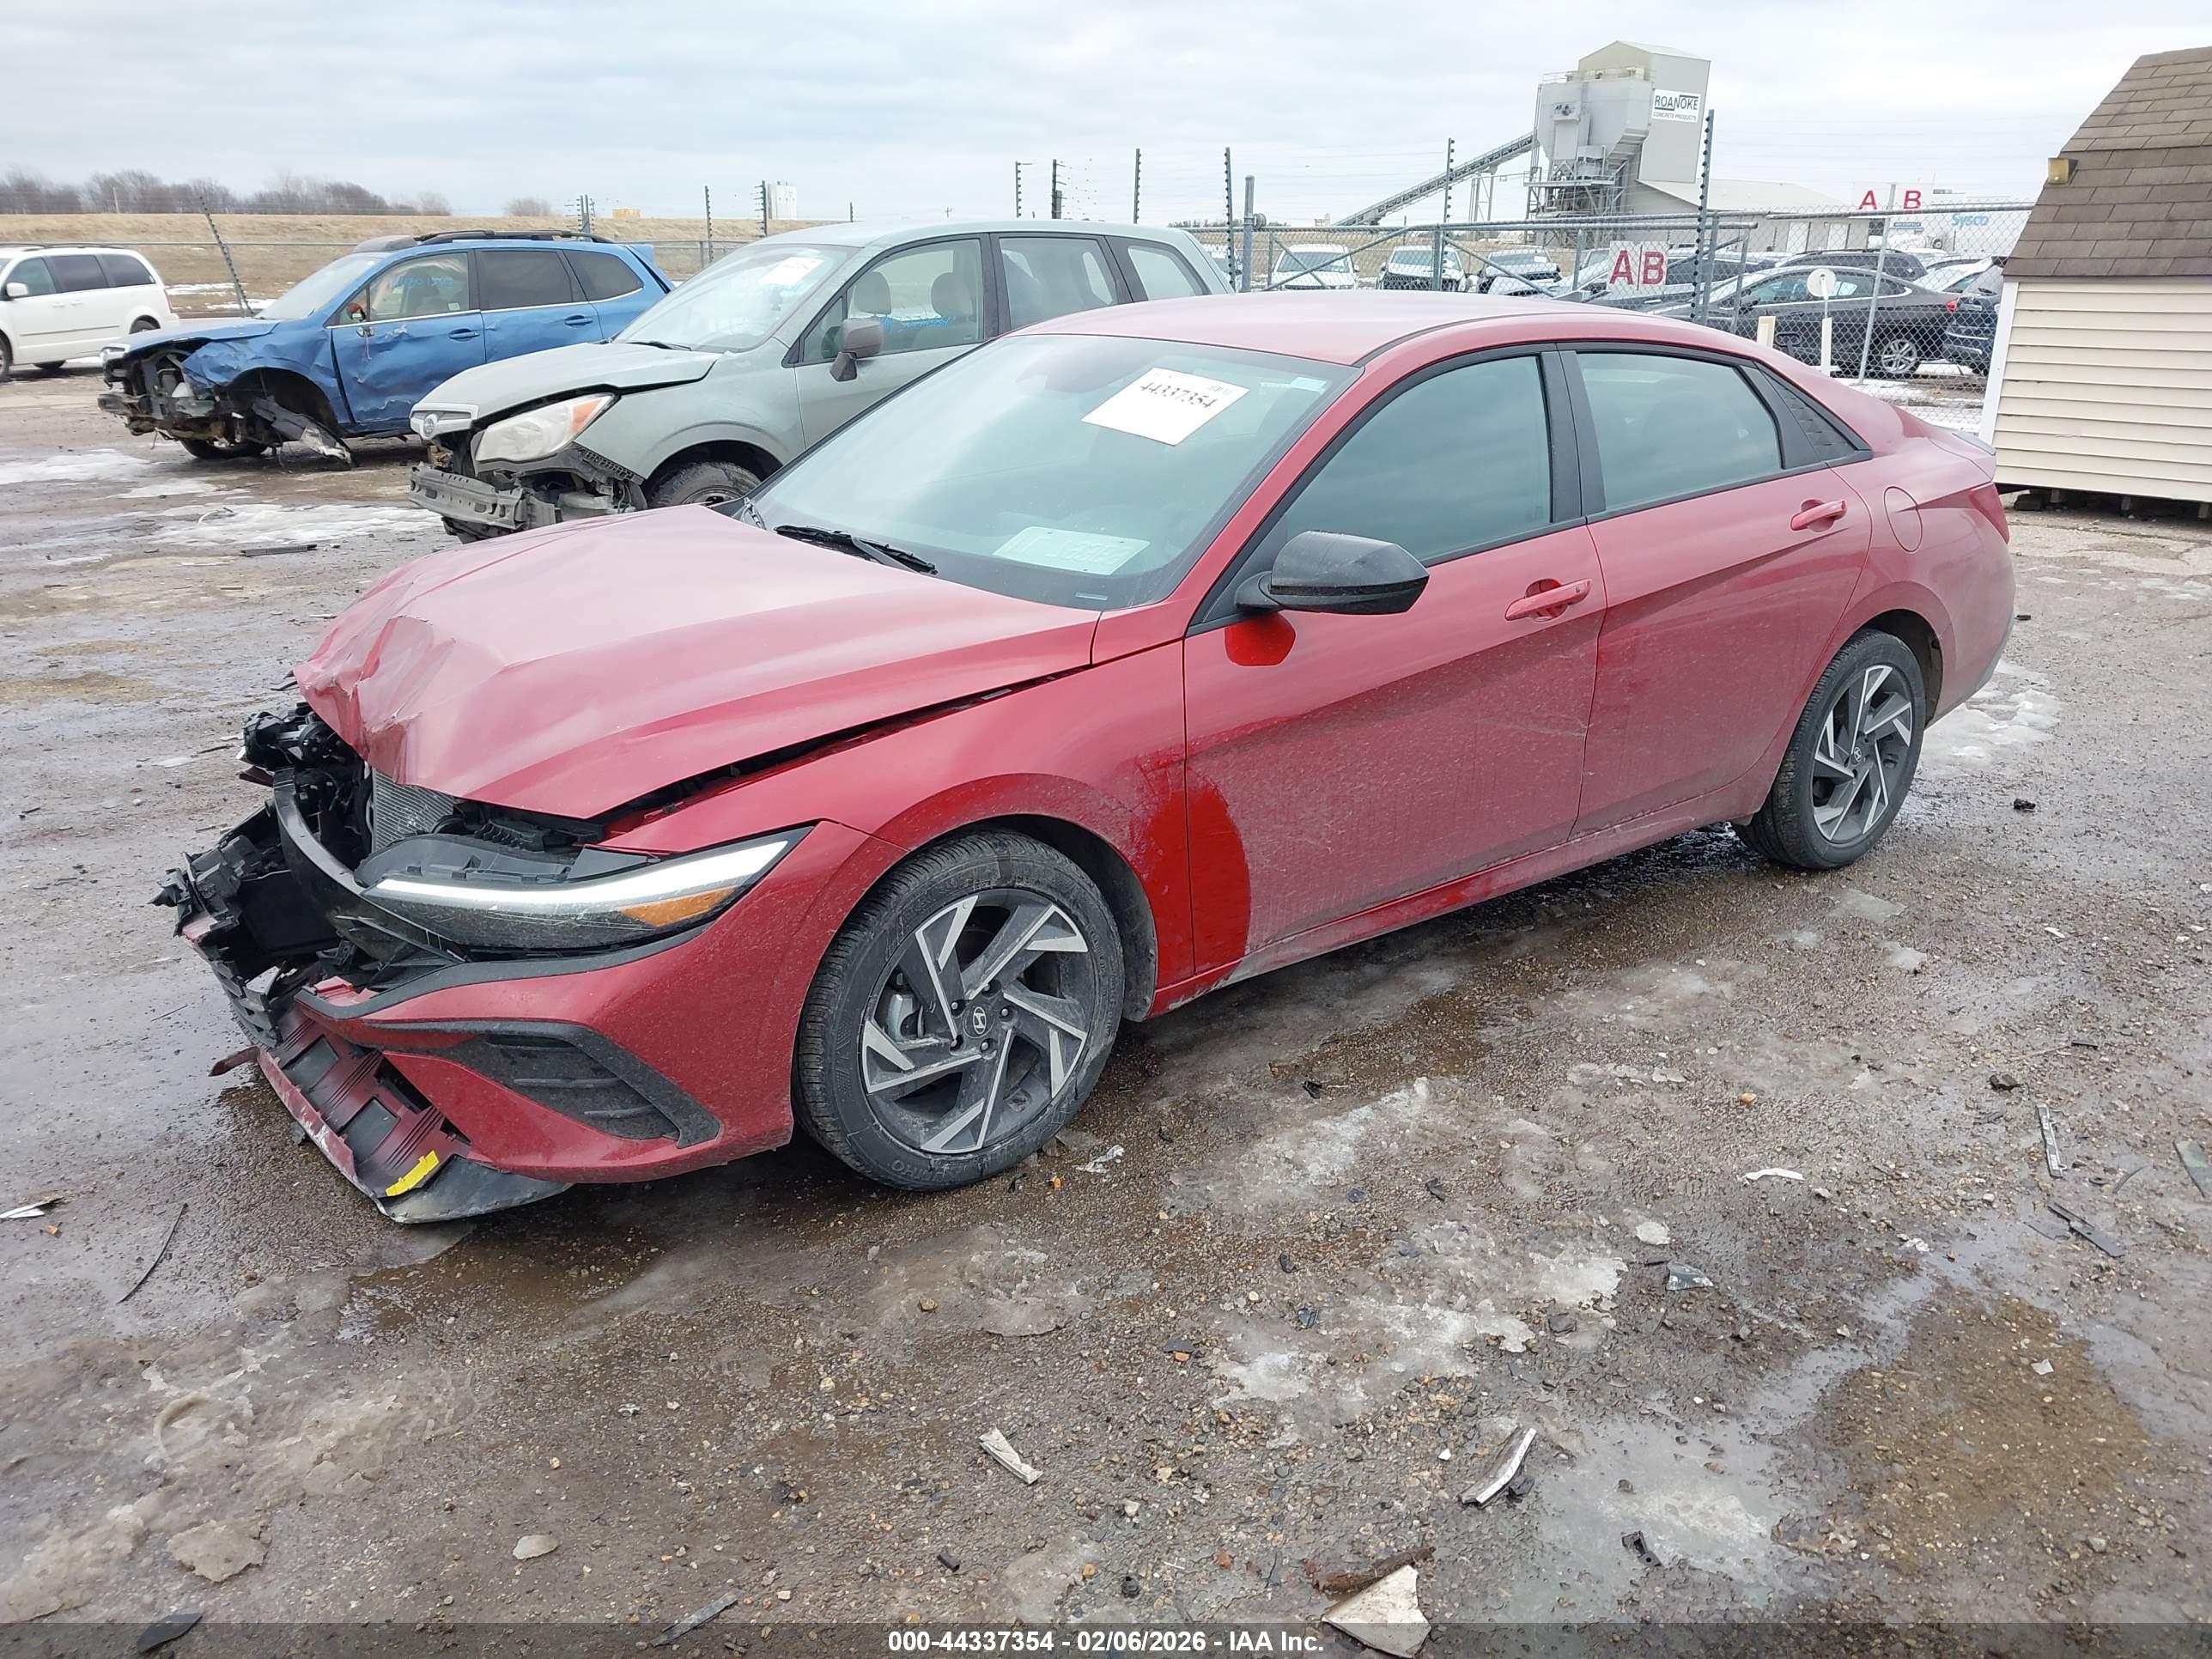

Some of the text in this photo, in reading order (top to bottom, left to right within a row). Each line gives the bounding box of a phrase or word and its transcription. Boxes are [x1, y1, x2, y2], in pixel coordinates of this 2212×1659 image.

[1654, 94, 1699, 111] ROANOKE
[1859, 189, 1923, 210] A B
[1951, 213, 1990, 229] Sysco
[1139, 381, 1218, 409] 44337354
